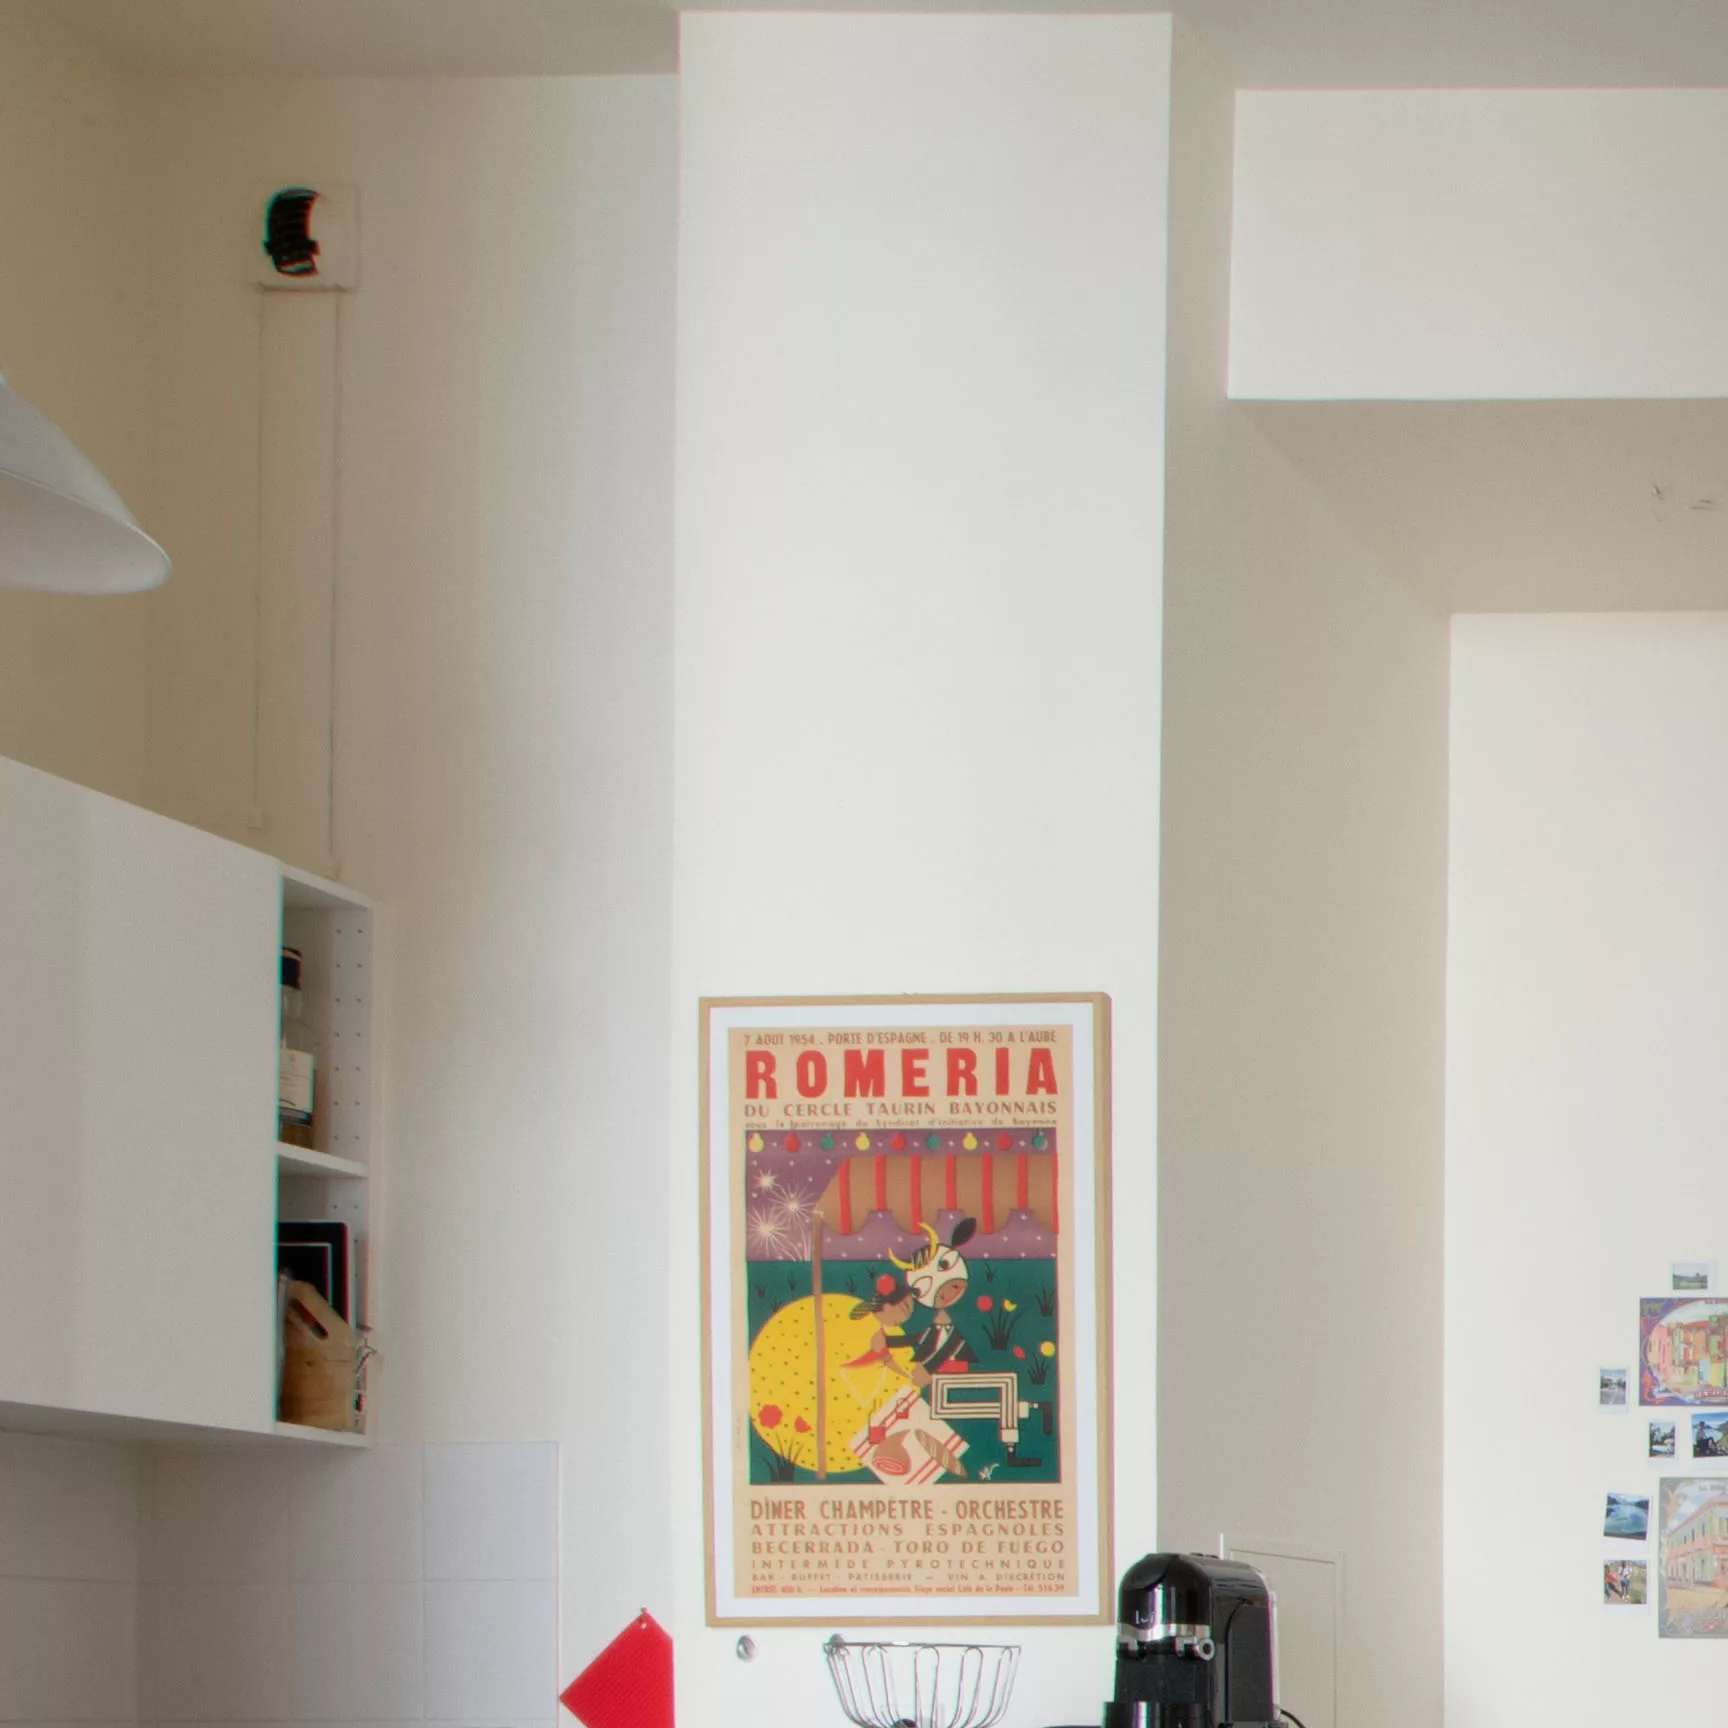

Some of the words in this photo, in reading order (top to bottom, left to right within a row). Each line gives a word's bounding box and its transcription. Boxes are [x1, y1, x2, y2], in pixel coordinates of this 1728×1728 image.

[790, 1033, 815, 1046] 1954
[828, 1033, 862, 1045] PORTE
[866, 1032, 927, 1045] D'ESPAGNE
[940, 1031, 953, 1044] DE
[745, 1046, 1059, 1100] ROMERIA
[744, 1103, 770, 1118] DU
[784, 1103, 853, 1117] CERCLE
[866, 1102, 936, 1116] TAURIN
[950, 1100, 1057, 1116] BAYONNAIS
[956, 1499, 1064, 1519] ORCHESTRE
[751, 1522, 904, 1537] ATTRACTIONS
[926, 1522, 1064, 1537] ESPAGNOLES
[751, 1540, 874, 1555] BECERRADA
[895, 1540, 950, 1554] TORO
[961, 1540, 986, 1554] DE
[998, 1540, 1064, 1554] FUEGO
[887, 1558, 1064, 1570] PYROTECHNIQUE
